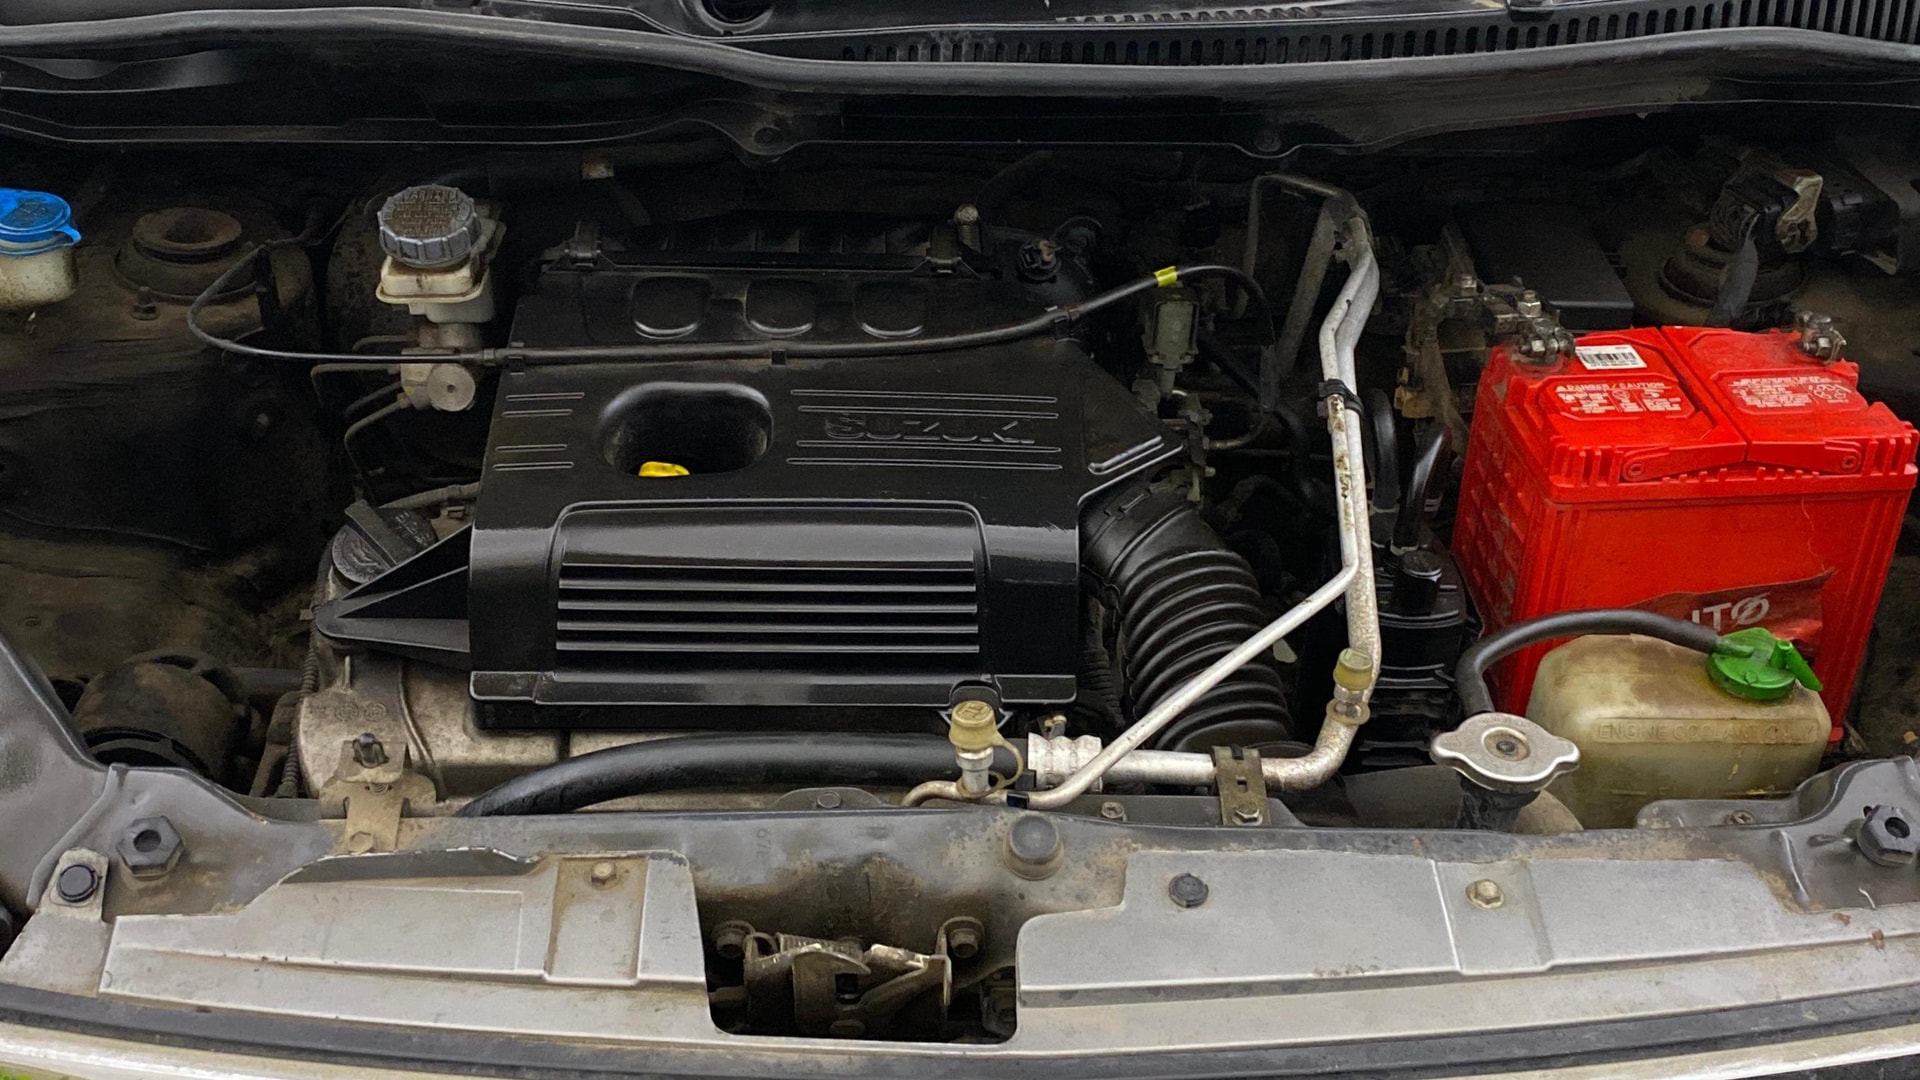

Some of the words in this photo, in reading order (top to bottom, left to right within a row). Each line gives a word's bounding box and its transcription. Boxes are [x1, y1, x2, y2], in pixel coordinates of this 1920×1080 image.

[1620, 382, 1665, 390] CAUTION
[825, 413, 1035, 444] SUZUKI
[1600, 723, 1666, 740] ENGINE
[1673, 723, 1761, 740] COOLANT
